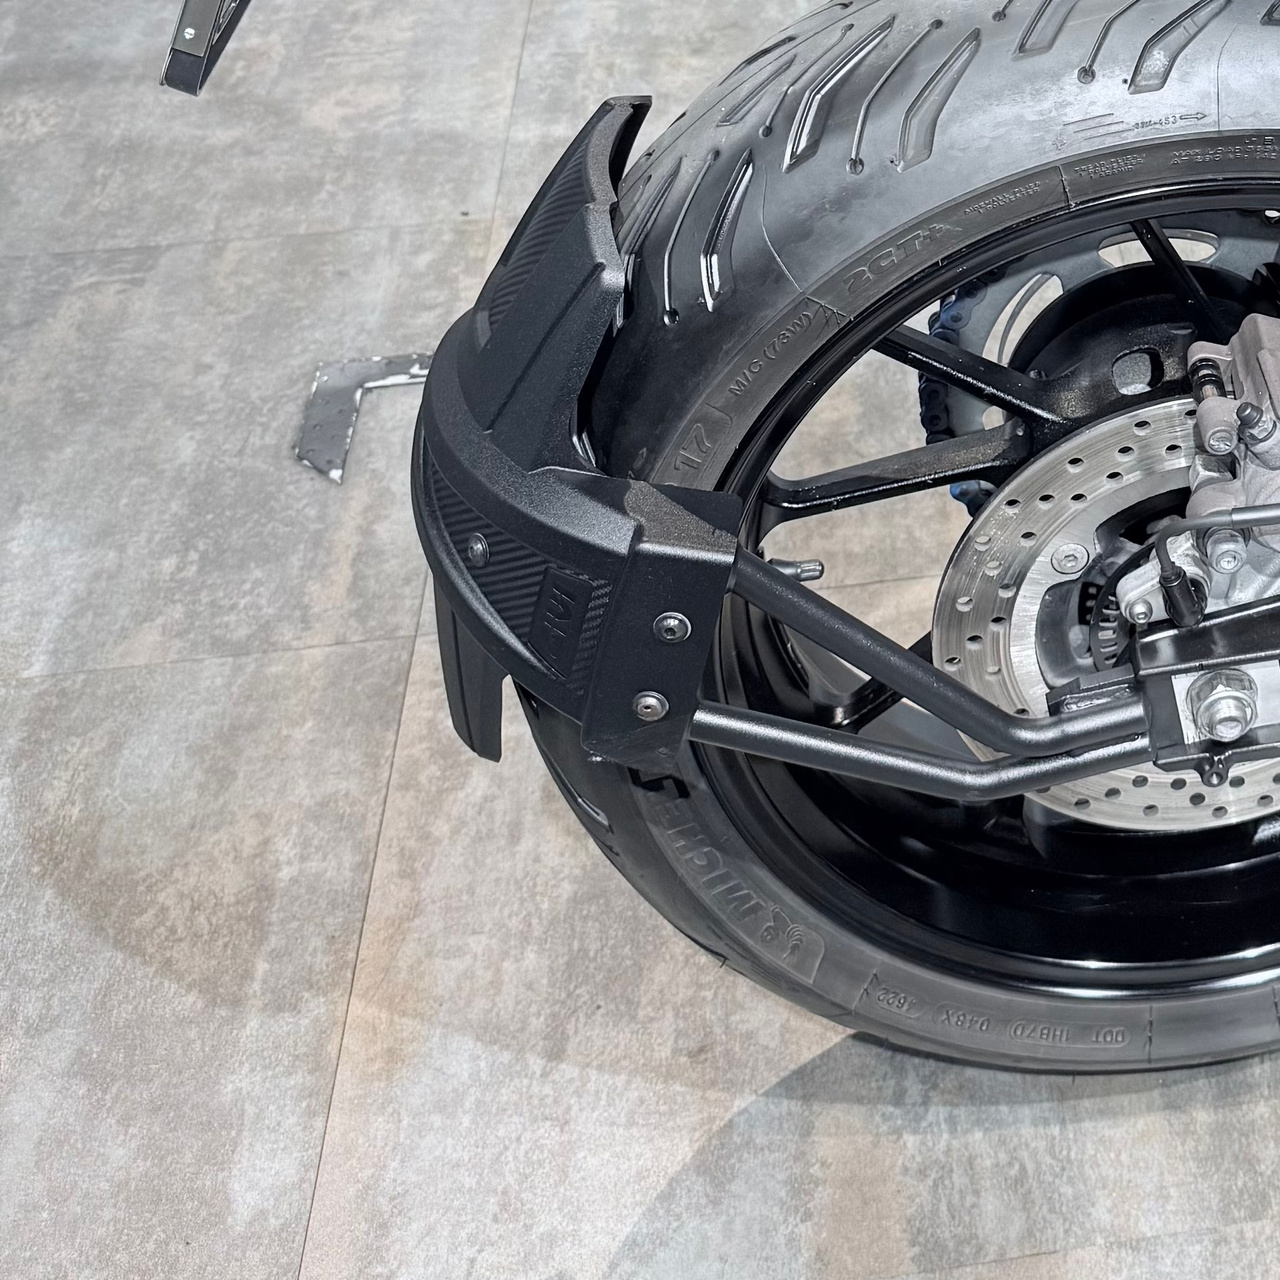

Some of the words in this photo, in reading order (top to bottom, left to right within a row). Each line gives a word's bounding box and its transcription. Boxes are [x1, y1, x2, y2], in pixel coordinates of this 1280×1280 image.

[674, 422, 712, 471] 17
[727, 358, 763, 397] M/C
[763, 311, 814, 360] (73W)
